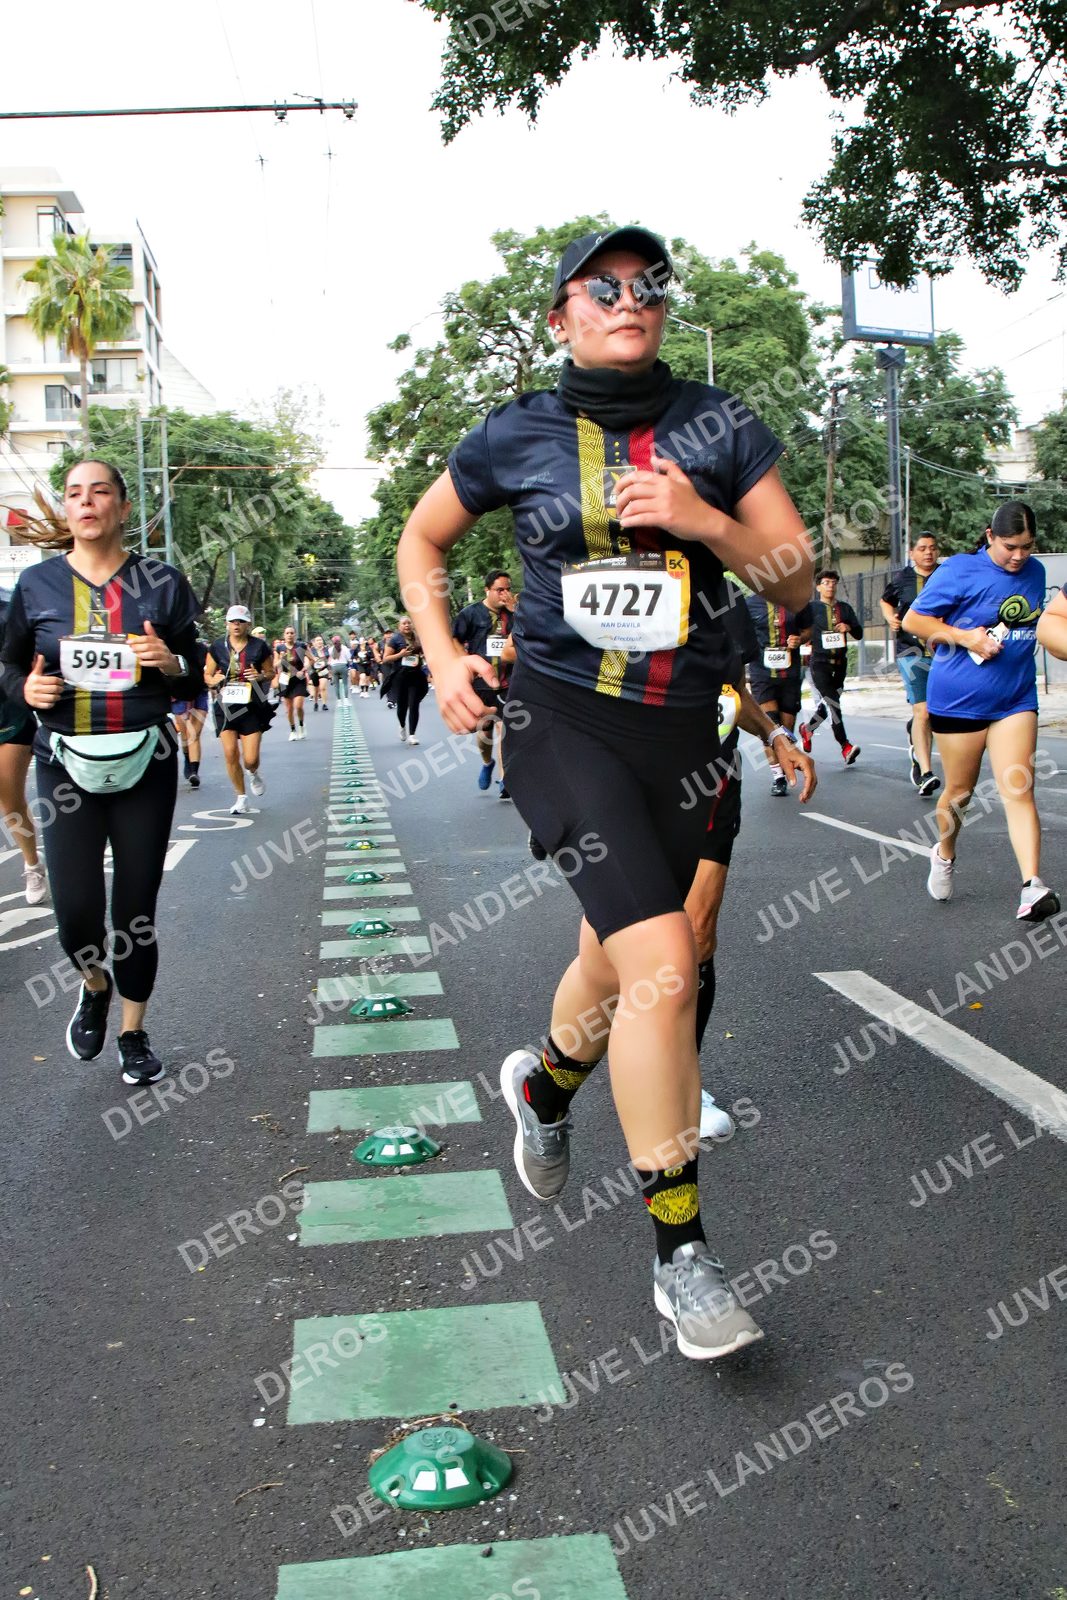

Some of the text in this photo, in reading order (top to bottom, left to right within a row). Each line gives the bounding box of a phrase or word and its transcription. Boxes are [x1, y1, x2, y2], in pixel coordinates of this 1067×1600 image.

[668, 559, 685, 570] 5K
[579, 583, 663, 616] 4727
[491, 641, 507, 649] 622
[72, 649, 122, 670] 5951
[767, 653, 786, 662] 6084
